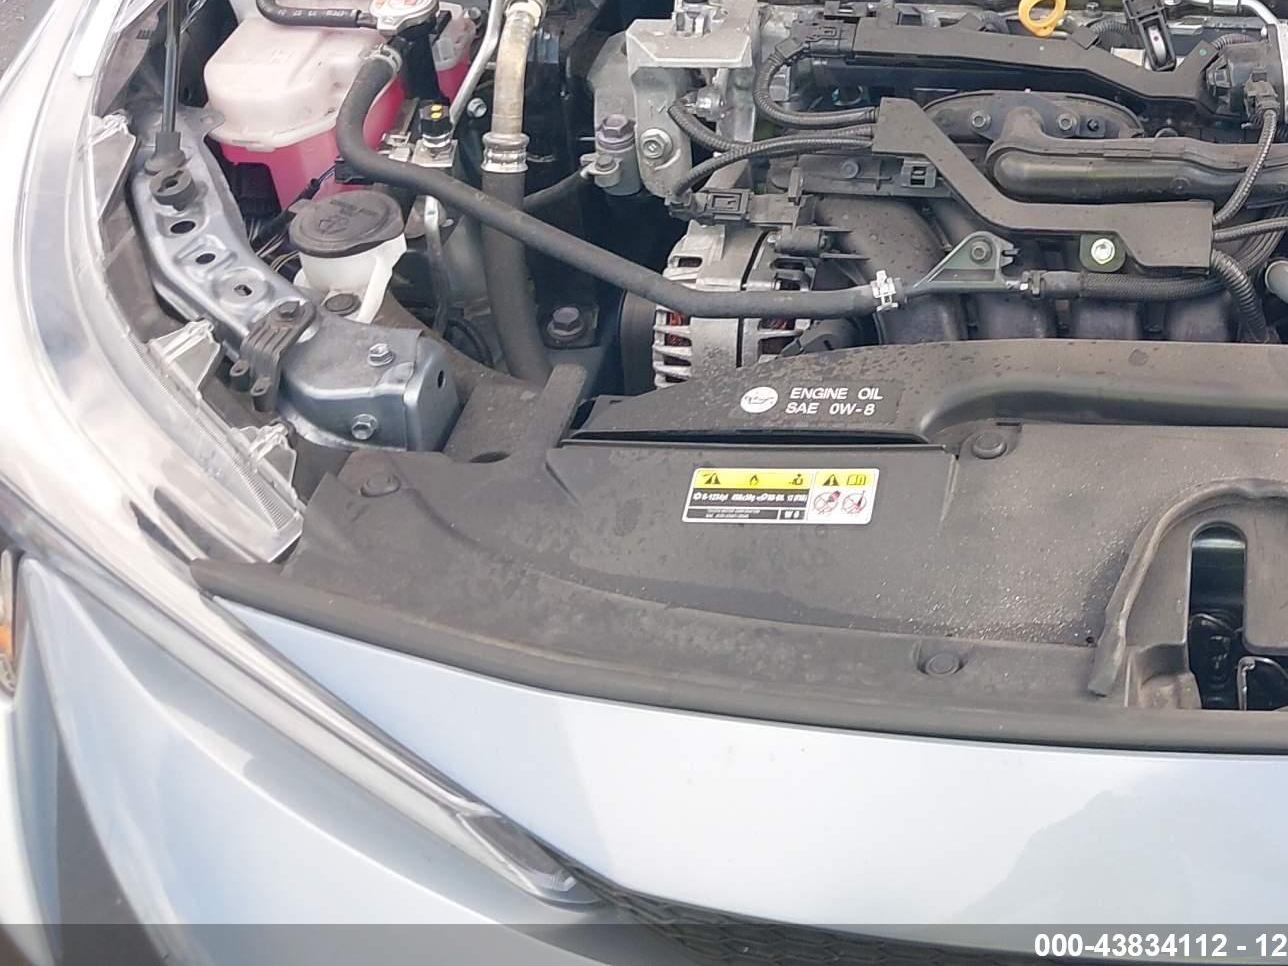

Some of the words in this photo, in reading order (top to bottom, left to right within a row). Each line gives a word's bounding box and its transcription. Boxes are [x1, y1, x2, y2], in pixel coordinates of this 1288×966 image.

[790, 387, 849, 400] ENGINE
[857, 387, 883, 400] OIL
[785, 402, 819, 414] SAE
[829, 403, 875, 416] 0W-8
